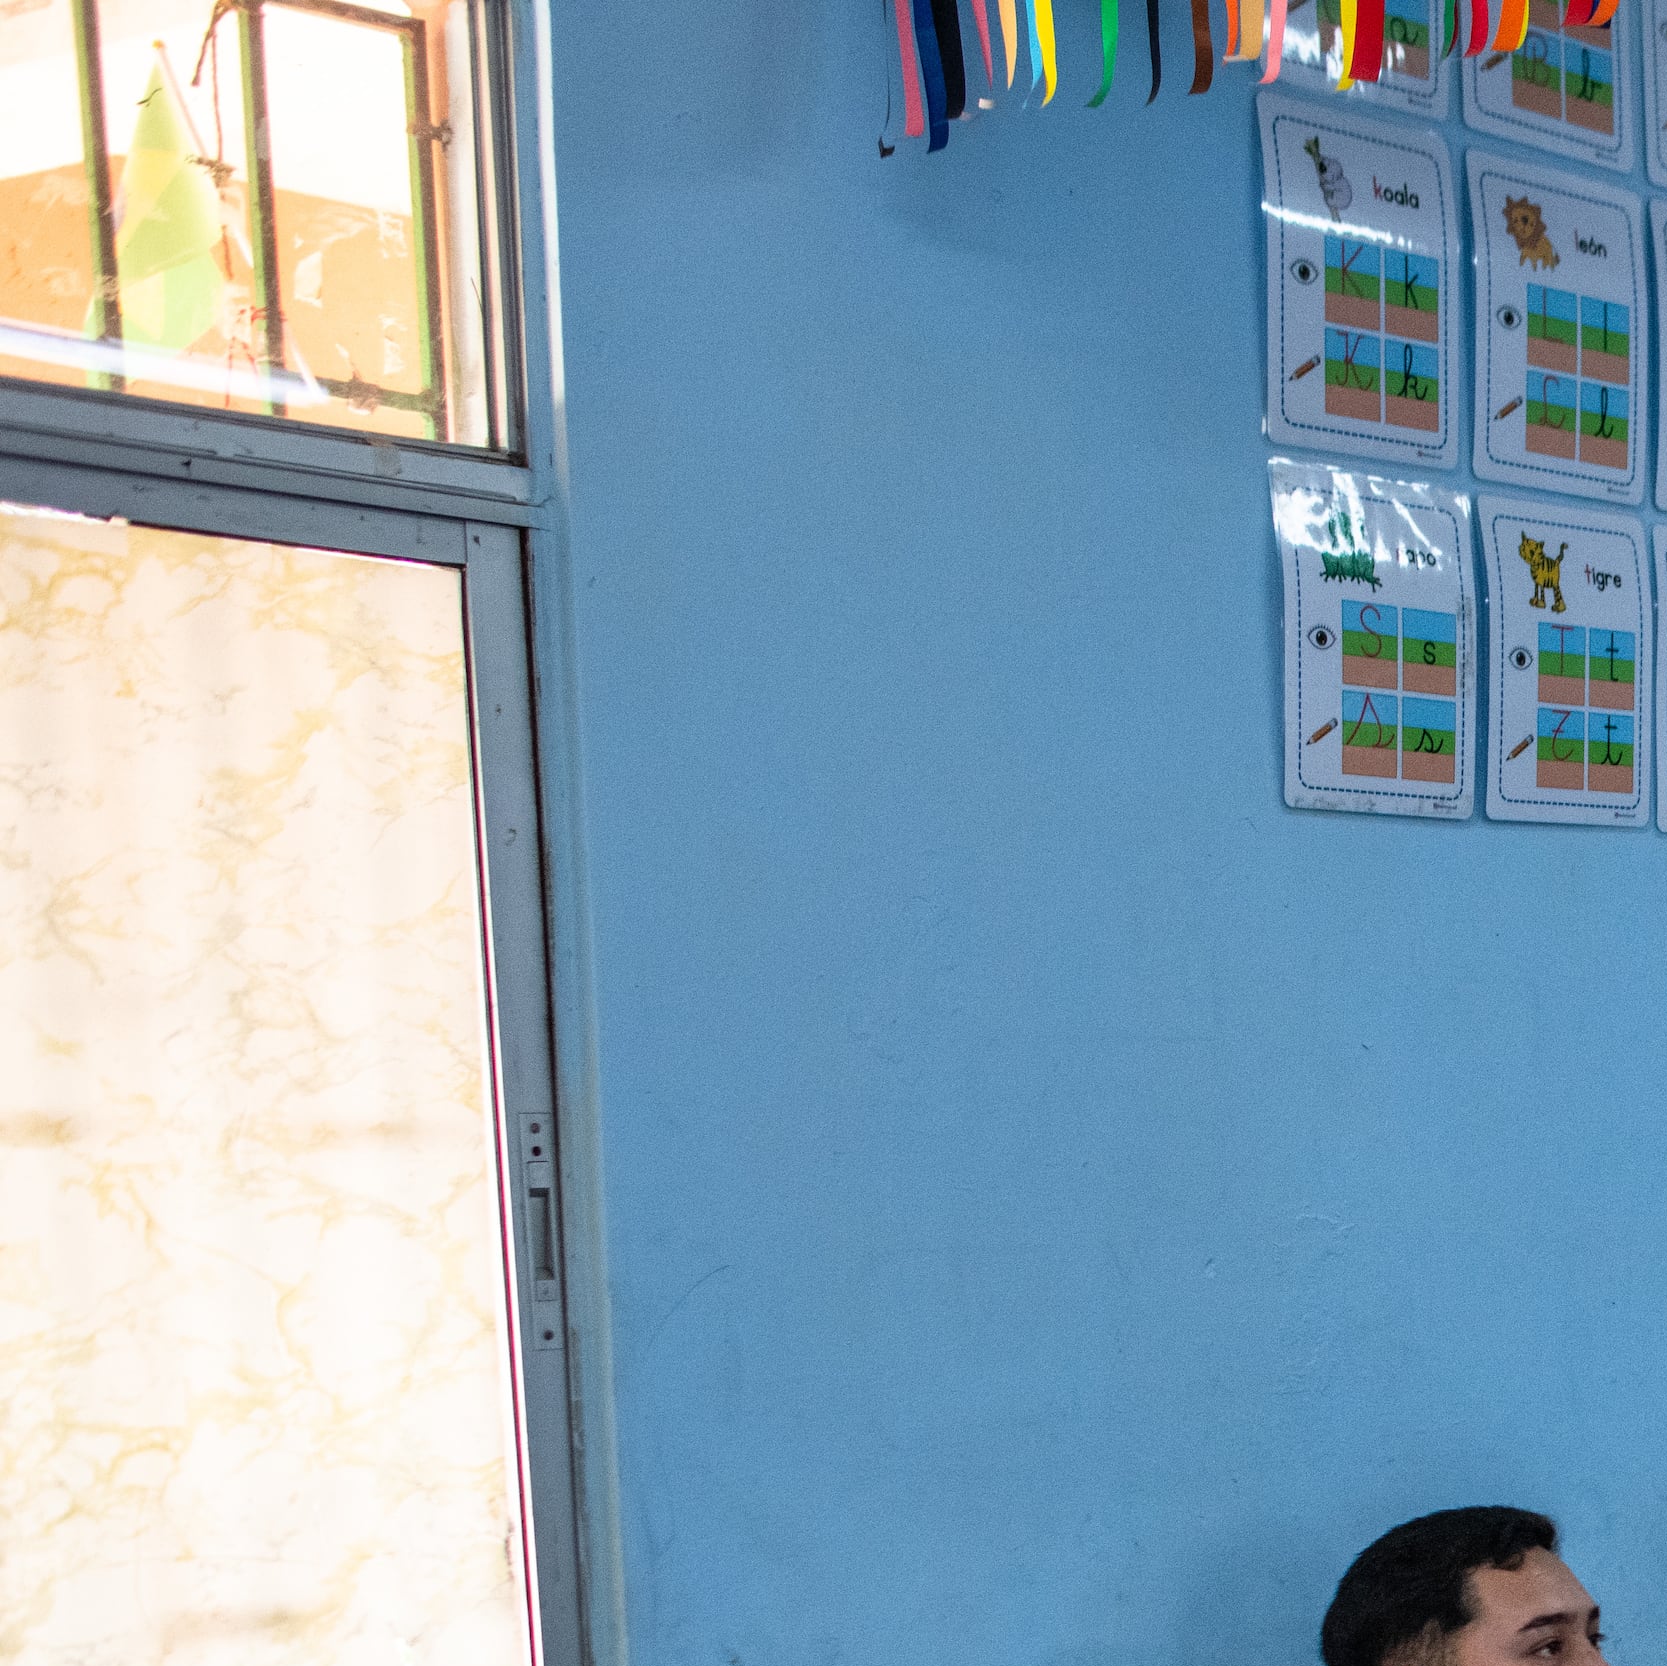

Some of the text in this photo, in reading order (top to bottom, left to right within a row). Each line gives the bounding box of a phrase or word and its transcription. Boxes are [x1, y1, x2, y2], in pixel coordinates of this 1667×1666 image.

[1372, 175, 1421, 209] koala
[1574, 227, 1608, 259] león
[1341, 239, 1420, 311] K k
[1334, 330, 1429, 401] K k
[1396, 548, 1437, 571] apo
[1584, 563, 1623, 593] tigre
[1360, 604, 1437, 665] S s
[1551, 624, 1620, 682] T t
[1600, 714, 1624, 767] t
